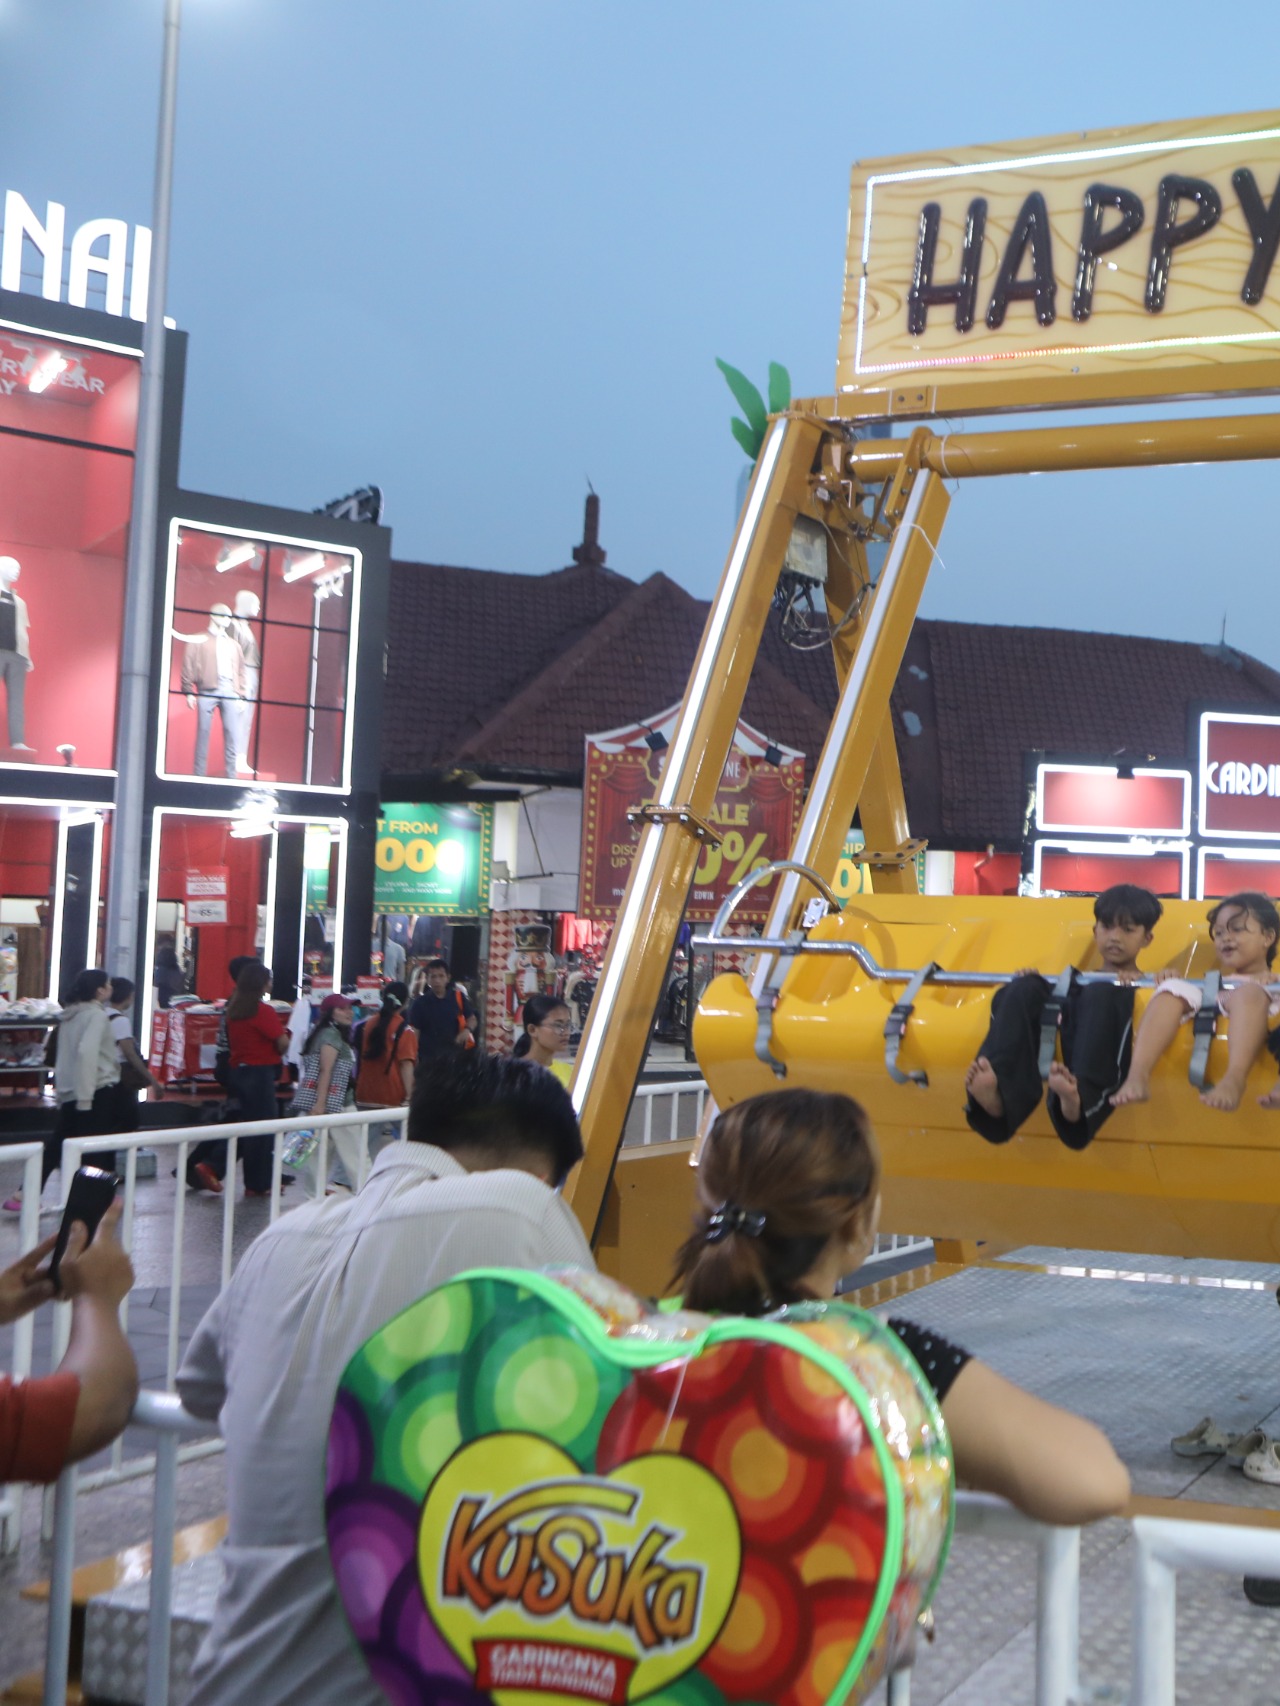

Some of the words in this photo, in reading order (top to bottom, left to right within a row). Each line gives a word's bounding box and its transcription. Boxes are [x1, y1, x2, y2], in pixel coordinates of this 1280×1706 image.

[53, 371, 105, 395] EAR
[709, 802, 750, 826] ALE
[389, 820, 439, 835] FROM
[611, 843, 638, 857] DISC
[611, 857, 628, 869] UP
[694, 890, 714, 900] EDWIN
